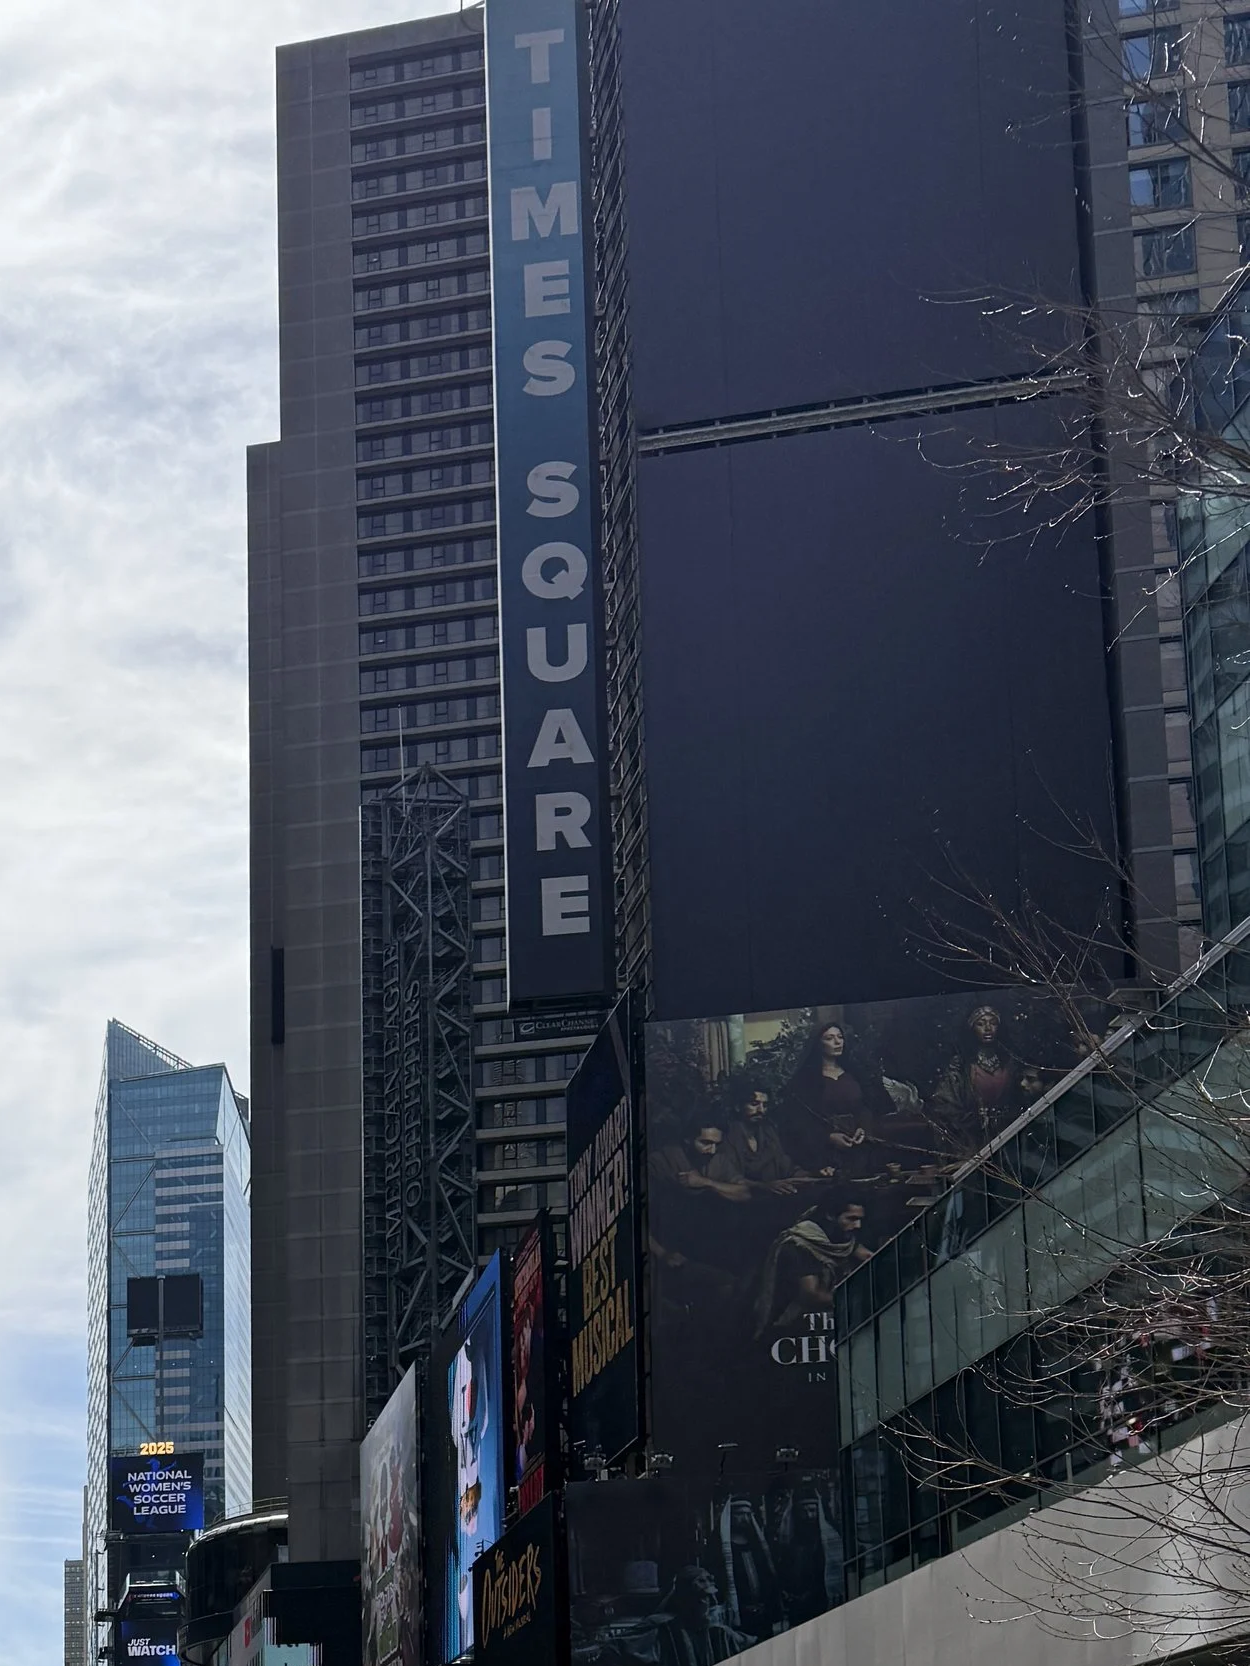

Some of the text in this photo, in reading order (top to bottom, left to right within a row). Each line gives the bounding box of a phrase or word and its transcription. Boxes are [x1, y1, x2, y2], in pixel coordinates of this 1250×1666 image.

[510, 29, 596, 937] TIMES SQUARE
[402, 979, 424, 1209] OUTFITTERS
[568, 1095, 628, 1188] TONY AWARD
[385, 1050, 403, 1263] AMERICAN
[569, 1138, 630, 1273] WINNER!
[582, 1224, 618, 1322] BEST
[803, 1312, 835, 1331] Th
[571, 1279, 635, 1399] MUSICAL
[808, 1372, 827, 1383] IN
[140, 1442, 175, 1456] 2025
[127, 1470, 192, 1482] NATIONAL
[128, 1481, 192, 1492] WOMEN'S
[133, 1493, 186, 1505] SOCCER
[133, 1504, 187, 1516] LEAGUE
[481, 1541, 542, 1650] OUTSIDERS
[127, 1638, 151, 1647] JUST
[127, 1645, 177, 1657] WATCH
